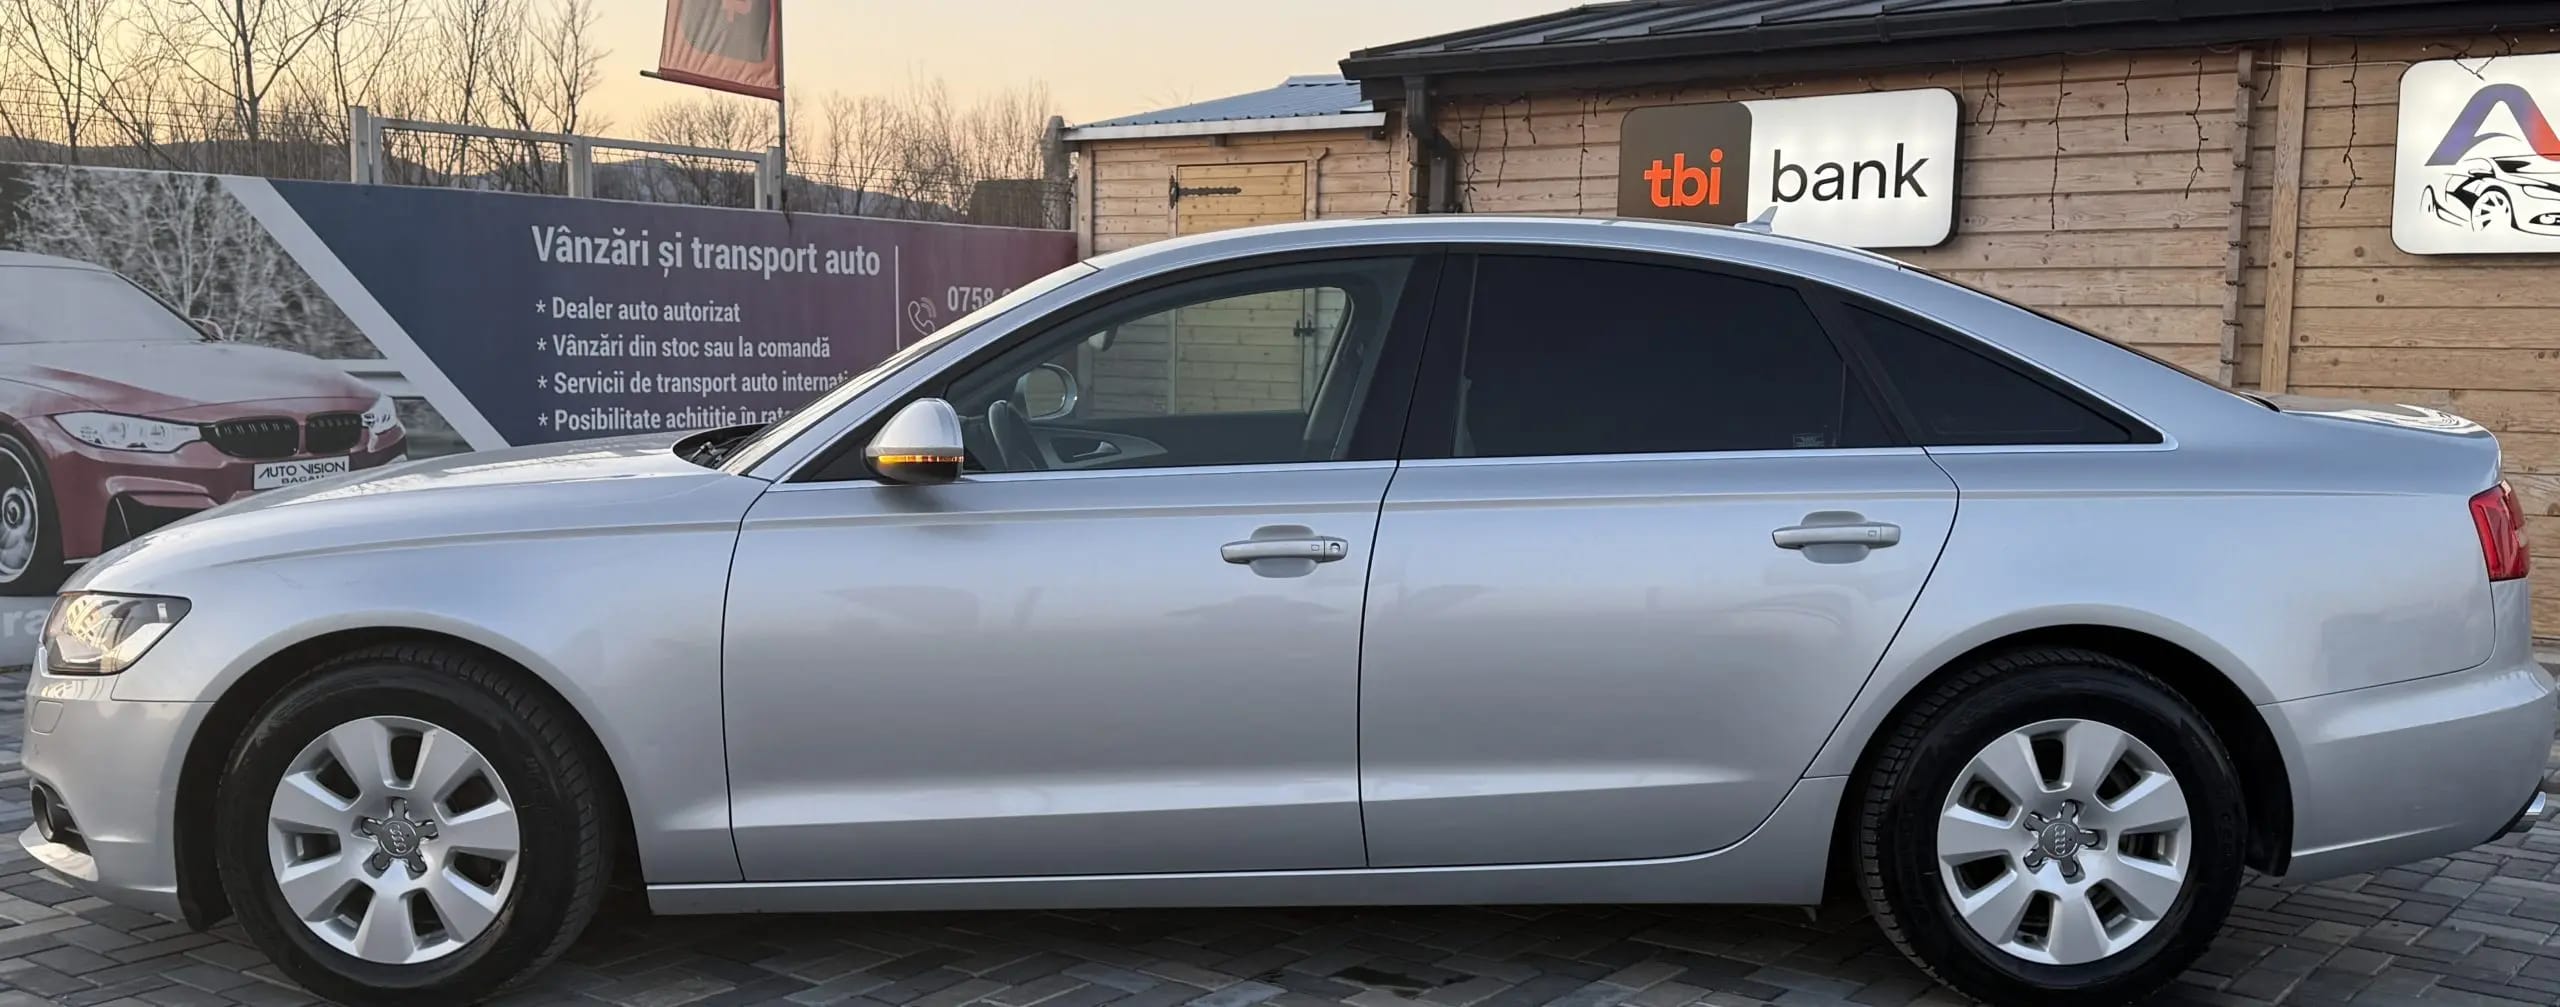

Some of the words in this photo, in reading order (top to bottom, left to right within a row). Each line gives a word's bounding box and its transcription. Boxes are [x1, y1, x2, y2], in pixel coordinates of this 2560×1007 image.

[1643, 148, 1723, 208] tbi
[1771, 142, 1930, 203] bank
[531, 224, 649, 267] Vânzări
[657, 231, 683, 278] și
[691, 236, 818, 281] transport
[825, 245, 881, 276] auto
[552, 296, 613, 320] Dealer
[618, 301, 658, 321] auto
[663, 300, 741, 322] autorizat
[552, 333, 624, 357] Vânzări
[628, 334, 657, 357] din
[662, 337, 700, 357] stoc
[704, 341, 734, 357] sau
[738, 335, 753, 358] la
[758, 336, 831, 358] comandă
[554, 370, 625, 394] Servicii
[630, 371, 651, 393] de
[656, 373, 737, 397] transport
[742, 373, 778, 392] auto
[554, 407, 661, 431] Posibilitate
[258, 465, 297, 479] AUTO
[300, 461, 346, 474] VISION
